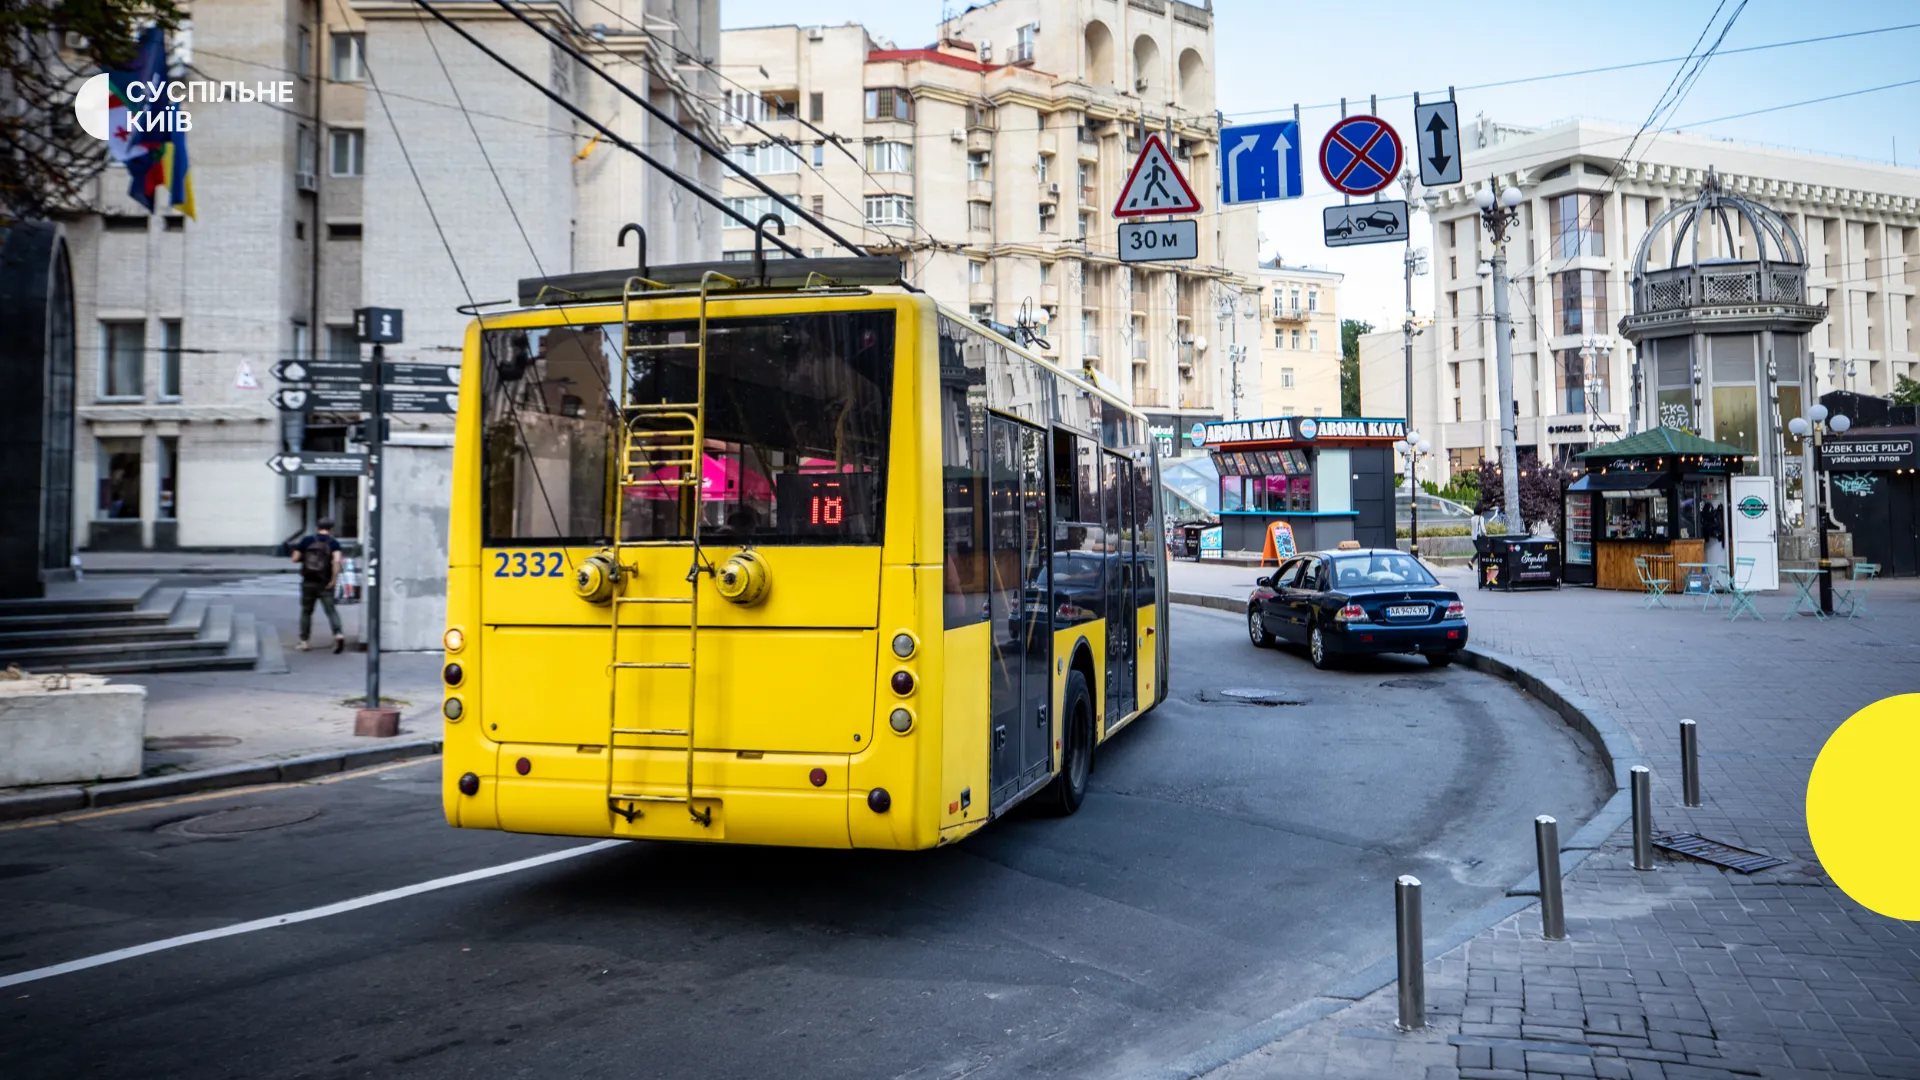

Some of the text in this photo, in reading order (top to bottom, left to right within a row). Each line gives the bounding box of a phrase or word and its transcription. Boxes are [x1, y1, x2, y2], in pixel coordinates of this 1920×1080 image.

[1130, 230, 1157, 250] 30
[1206, 419, 1291, 443] AROMA KAVA
[1317, 421, 1366, 436] AROMA
[1367, 422, 1405, 437] KAVA
[1821, 443, 1910, 454] UZBEK RICE PILAF
[1831, 454, 1877, 464] узбецький
[812, 483, 842, 524] 18
[494, 551, 565, 578] 2332
